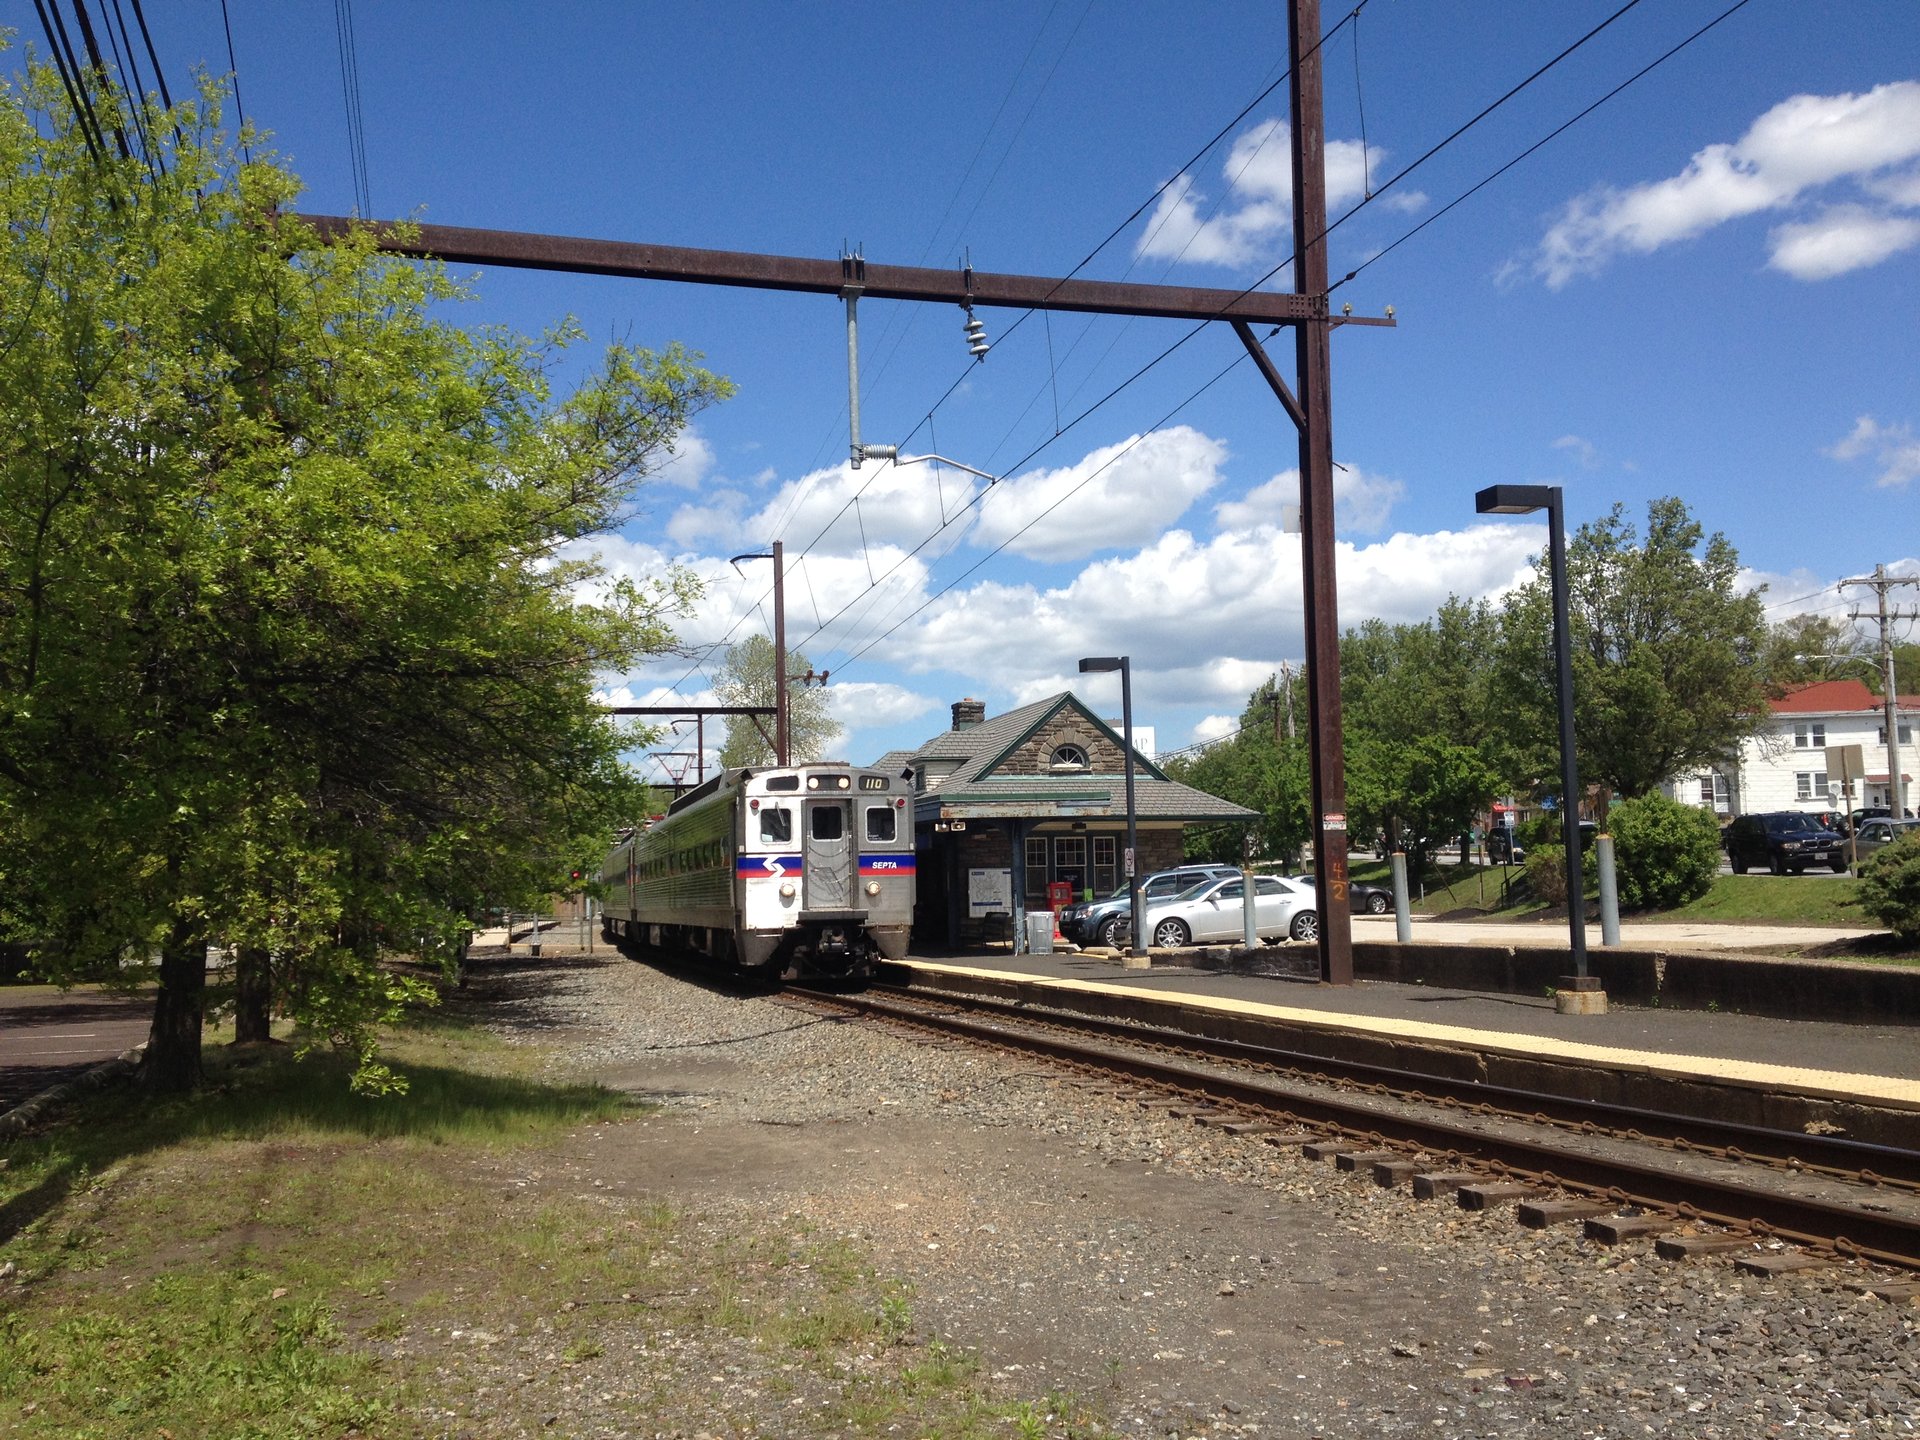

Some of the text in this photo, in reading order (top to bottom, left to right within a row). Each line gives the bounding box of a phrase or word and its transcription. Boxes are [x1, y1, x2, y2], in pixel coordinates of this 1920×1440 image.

[866, 778, 882, 789] 110
[872, 861, 897, 869] SEPTA
[1333, 884, 1345, 900] 2
